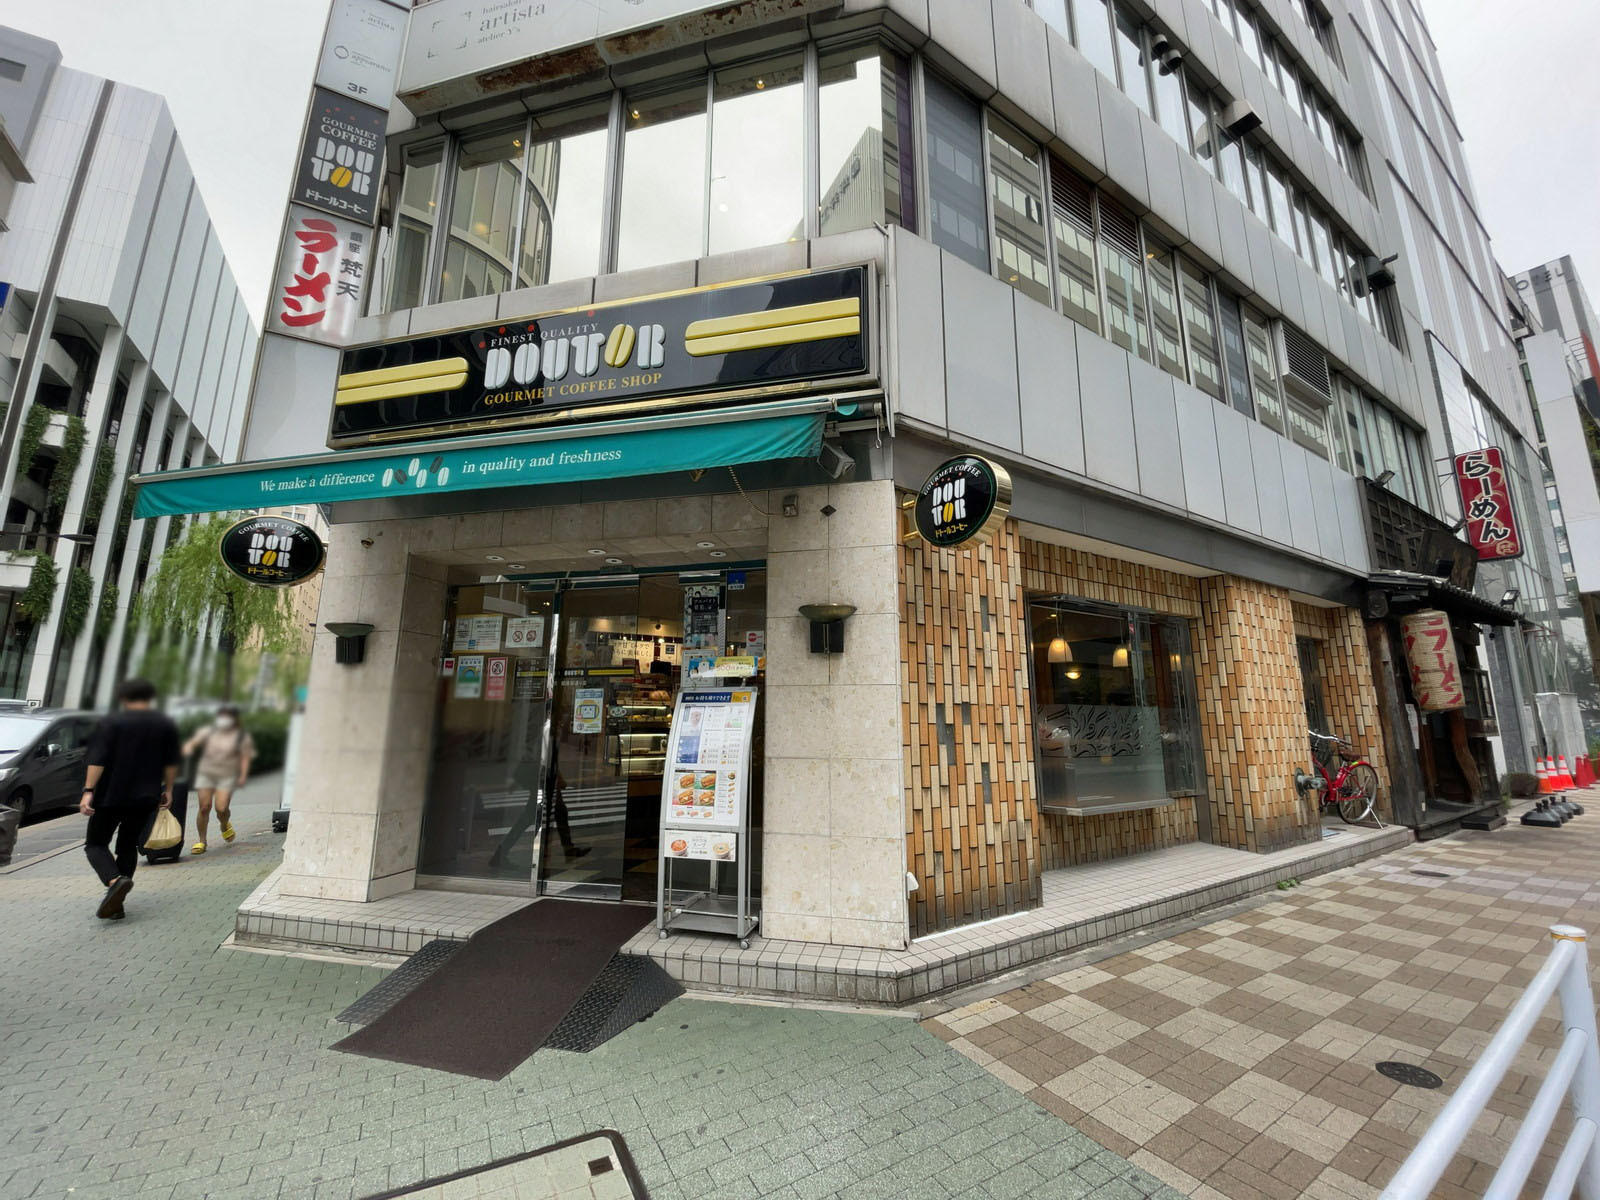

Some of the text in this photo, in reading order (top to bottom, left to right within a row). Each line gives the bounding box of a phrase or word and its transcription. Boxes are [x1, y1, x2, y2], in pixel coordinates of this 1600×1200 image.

[480, 4, 545, 31] artista
[477, 31, 505, 44] atelier
[347, 82, 368, 94] 3F
[321, 124, 377, 150] COFFEE
[322, 116, 379, 140] GOURMET
[316, 136, 374, 173] DOU
[310, 157, 371, 195] TOR
[305, 188, 368, 214] ドトールコーヒー
[280, 219, 338, 327] ラーメン
[336, 258, 363, 300] 梵天
[1515, 267, 1566, 291] OTEL
[491, 322, 598, 348] FINEST QUALITY
[484, 323, 666, 390] DOUTOR
[484, 372, 662, 406] GOURMET COFFEE SHOP
[260, 449, 622, 492] We make a difference in quality and freshness
[923, 464, 981, 496] GOURMET COFFEE
[932, 478, 966, 506] DOU
[1463, 454, 1511, 543] らーめん
[931, 498, 967, 526] TOR
[238, 522, 310, 542] GOURMET COFFEE
[251, 533, 294, 552] DOU
[935, 523, 968, 538] ドトールコーヒー
[247, 548, 291, 568] TOR
[1421, 618, 1463, 705] ラーメン
